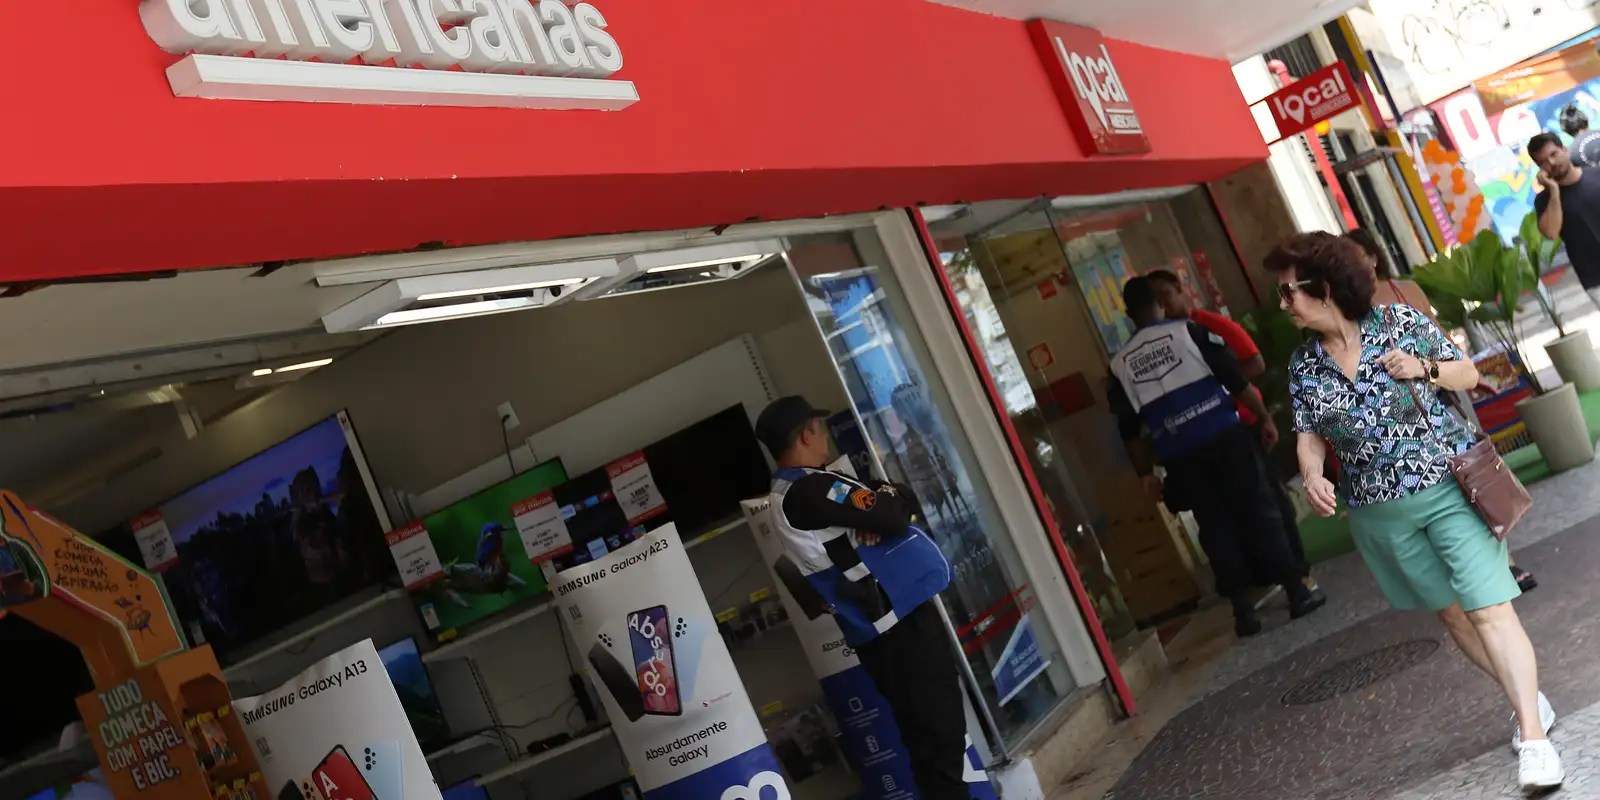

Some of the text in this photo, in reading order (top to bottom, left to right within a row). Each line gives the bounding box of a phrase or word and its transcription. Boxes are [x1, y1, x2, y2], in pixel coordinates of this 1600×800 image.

[142, 0, 624, 78] americanas
[1055, 37, 1129, 131] local
[1273, 68, 1347, 125] local
[557, 538, 670, 597] SAMSUNG Galaxy A23
[97, 678, 142, 716] TUDO
[242, 659, 368, 726] SAMSUNG Galaxy A13
[107, 726, 184, 772] COM PAPEL
[645, 721, 728, 761] Absurdamente
[668, 744, 708, 767] Galaxy
[131, 754, 180, 789] E BIC.
